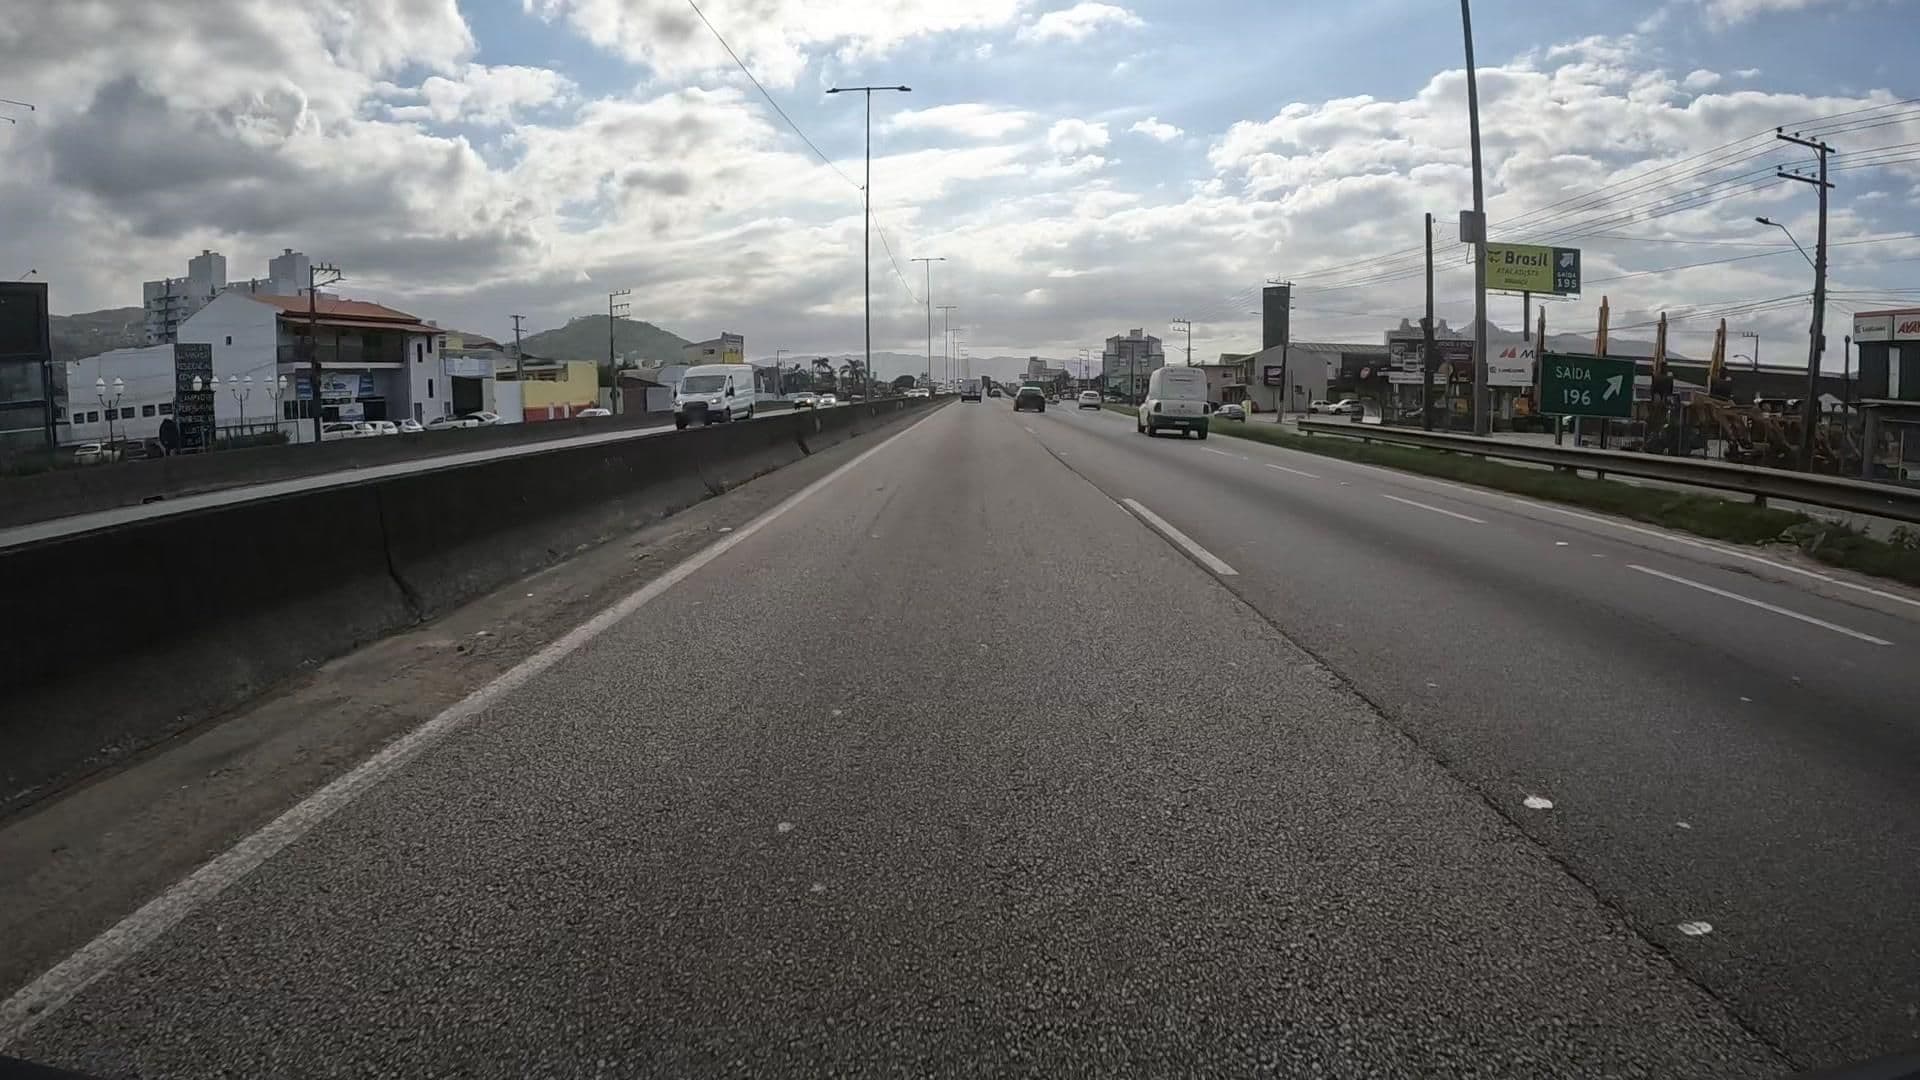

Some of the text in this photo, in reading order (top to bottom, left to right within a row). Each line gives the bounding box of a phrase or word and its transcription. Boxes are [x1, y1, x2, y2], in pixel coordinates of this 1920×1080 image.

[1504, 250, 1548, 267] Brasil
[1557, 278, 1577, 288] 195
[1555, 364, 1592, 381] SAÍDA
[1563, 389, 1591, 406] 196
